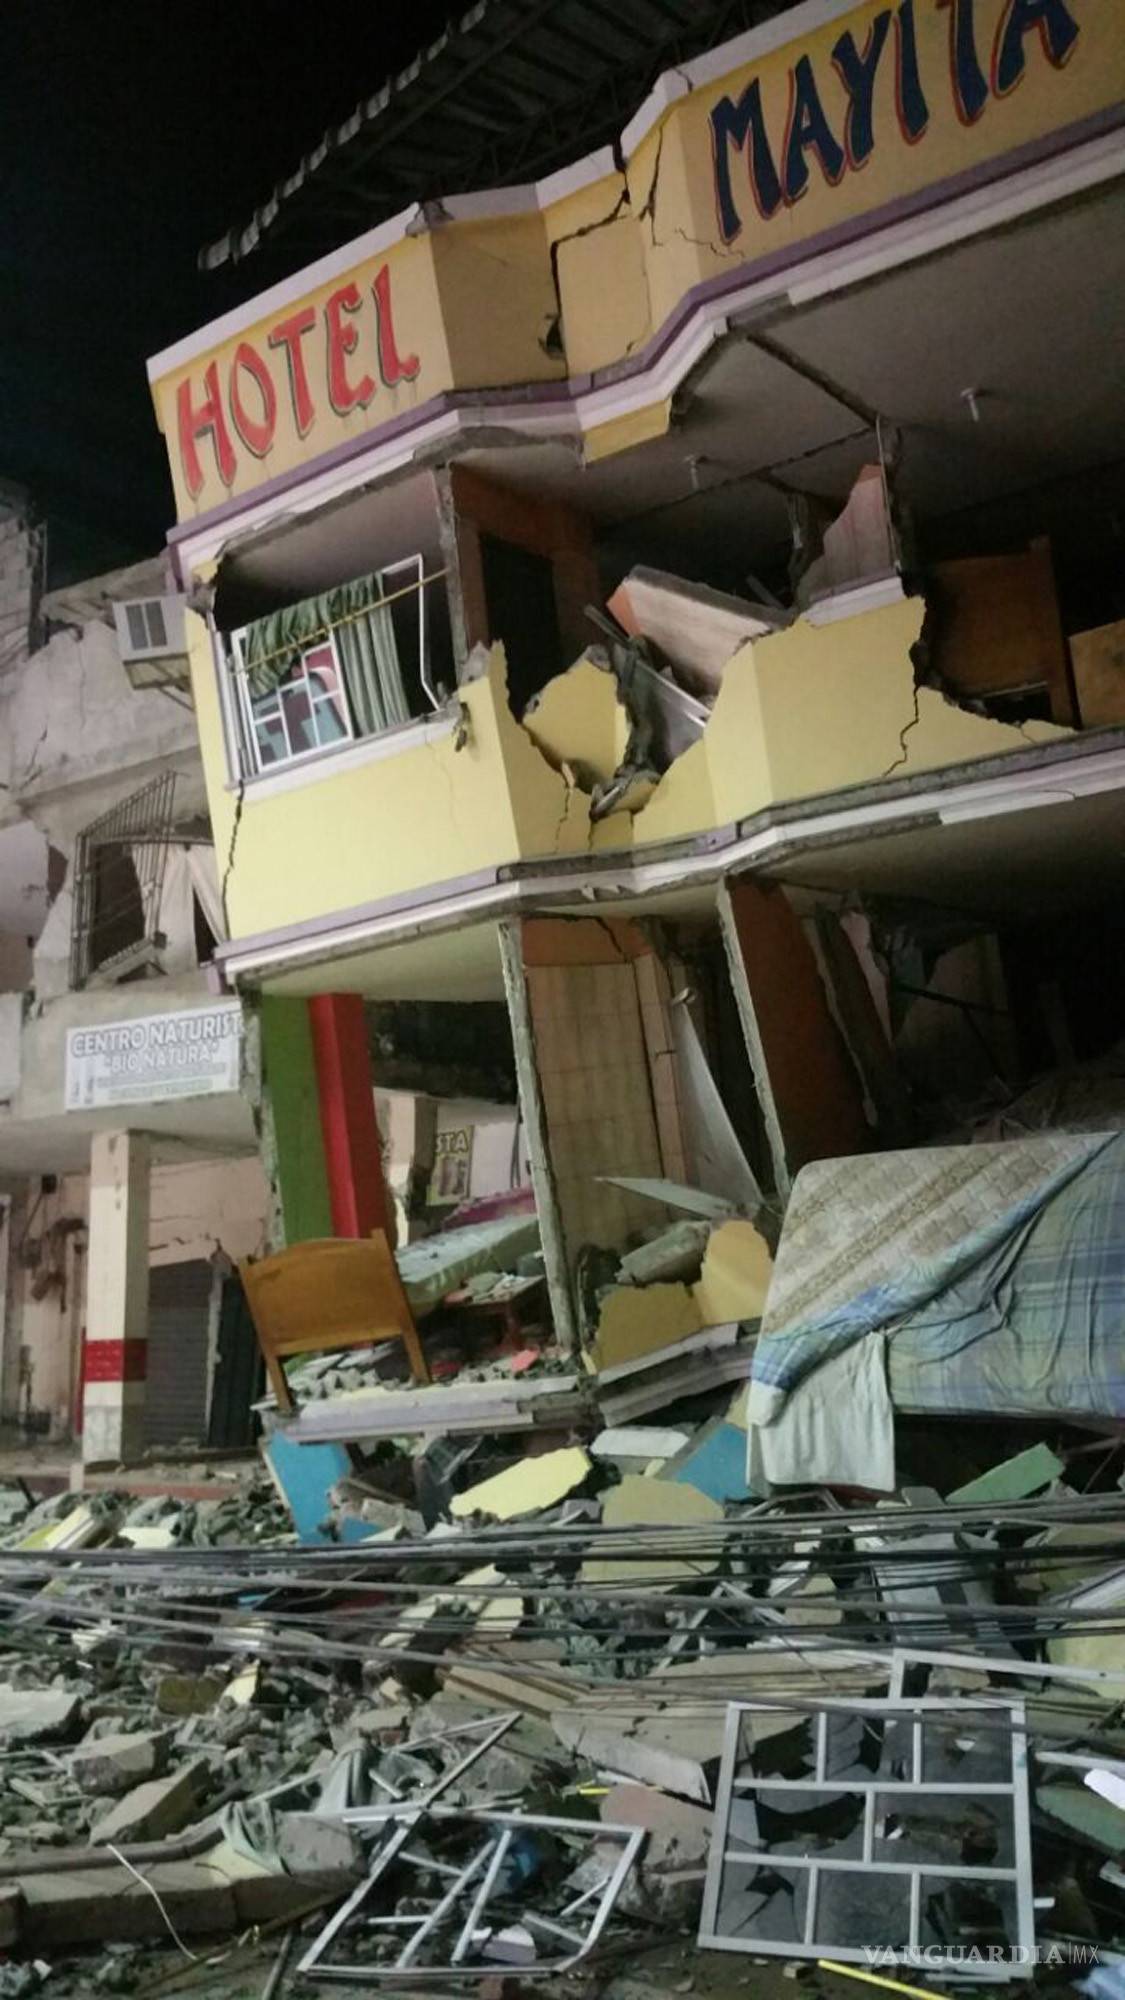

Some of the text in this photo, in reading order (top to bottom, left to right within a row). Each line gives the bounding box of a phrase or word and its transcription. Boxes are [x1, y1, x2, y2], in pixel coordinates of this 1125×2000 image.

[176, 0, 1080, 501] HOTEL MAYITA
[73, 1012, 244, 1057] CENTRO NATURIST
